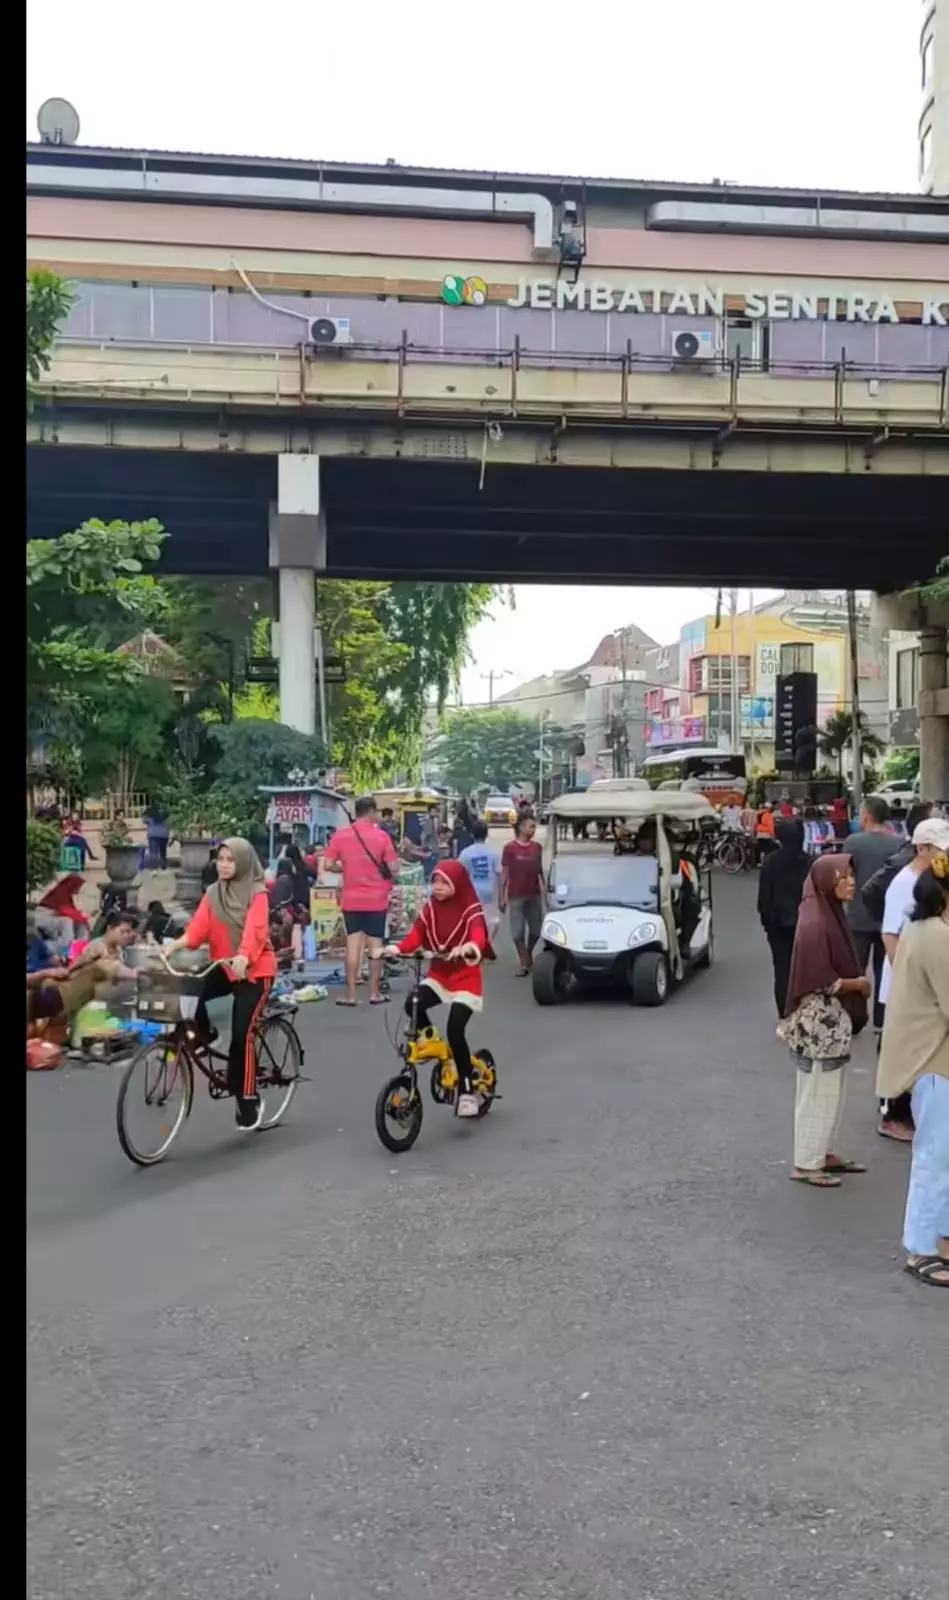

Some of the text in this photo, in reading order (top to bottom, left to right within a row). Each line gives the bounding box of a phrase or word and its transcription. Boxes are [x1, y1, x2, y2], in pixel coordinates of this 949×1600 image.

[507, 277, 725, 315] JEMBATAN
[744, 289, 900, 323] SENTRA
[275, 805, 312, 822] AYAM
